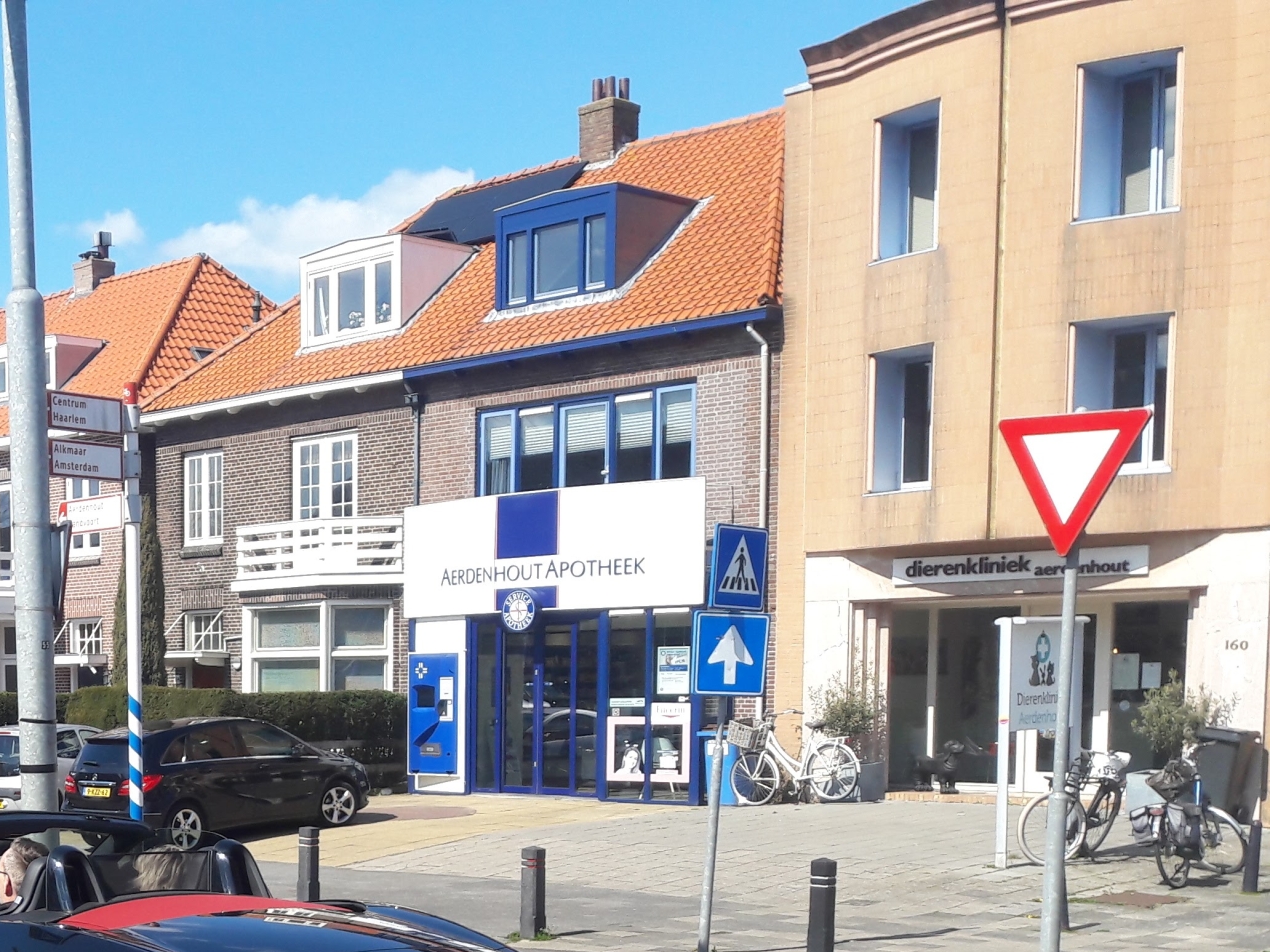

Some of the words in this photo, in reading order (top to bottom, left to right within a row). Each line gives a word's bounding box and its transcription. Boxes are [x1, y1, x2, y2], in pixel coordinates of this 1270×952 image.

[53, 396, 87, 409] Centrum
[53, 412, 86, 425] Haarlem
[54, 443, 87, 456] Alkmaar
[54, 459, 99, 473] Amsterdam
[545, 557, 646, 579] APOTHEEK
[905, 555, 1031, 577] dierenkliniek
[1034, 560, 1130, 576] aernhout
[505, 592, 532, 606] SERVICE
[504, 612, 533, 630] APOTHEEK
[1225, 640, 1249, 651] 160
[1017, 690, 1058, 706] Dierenklini
[1019, 709, 1057, 725] Aerdenho
